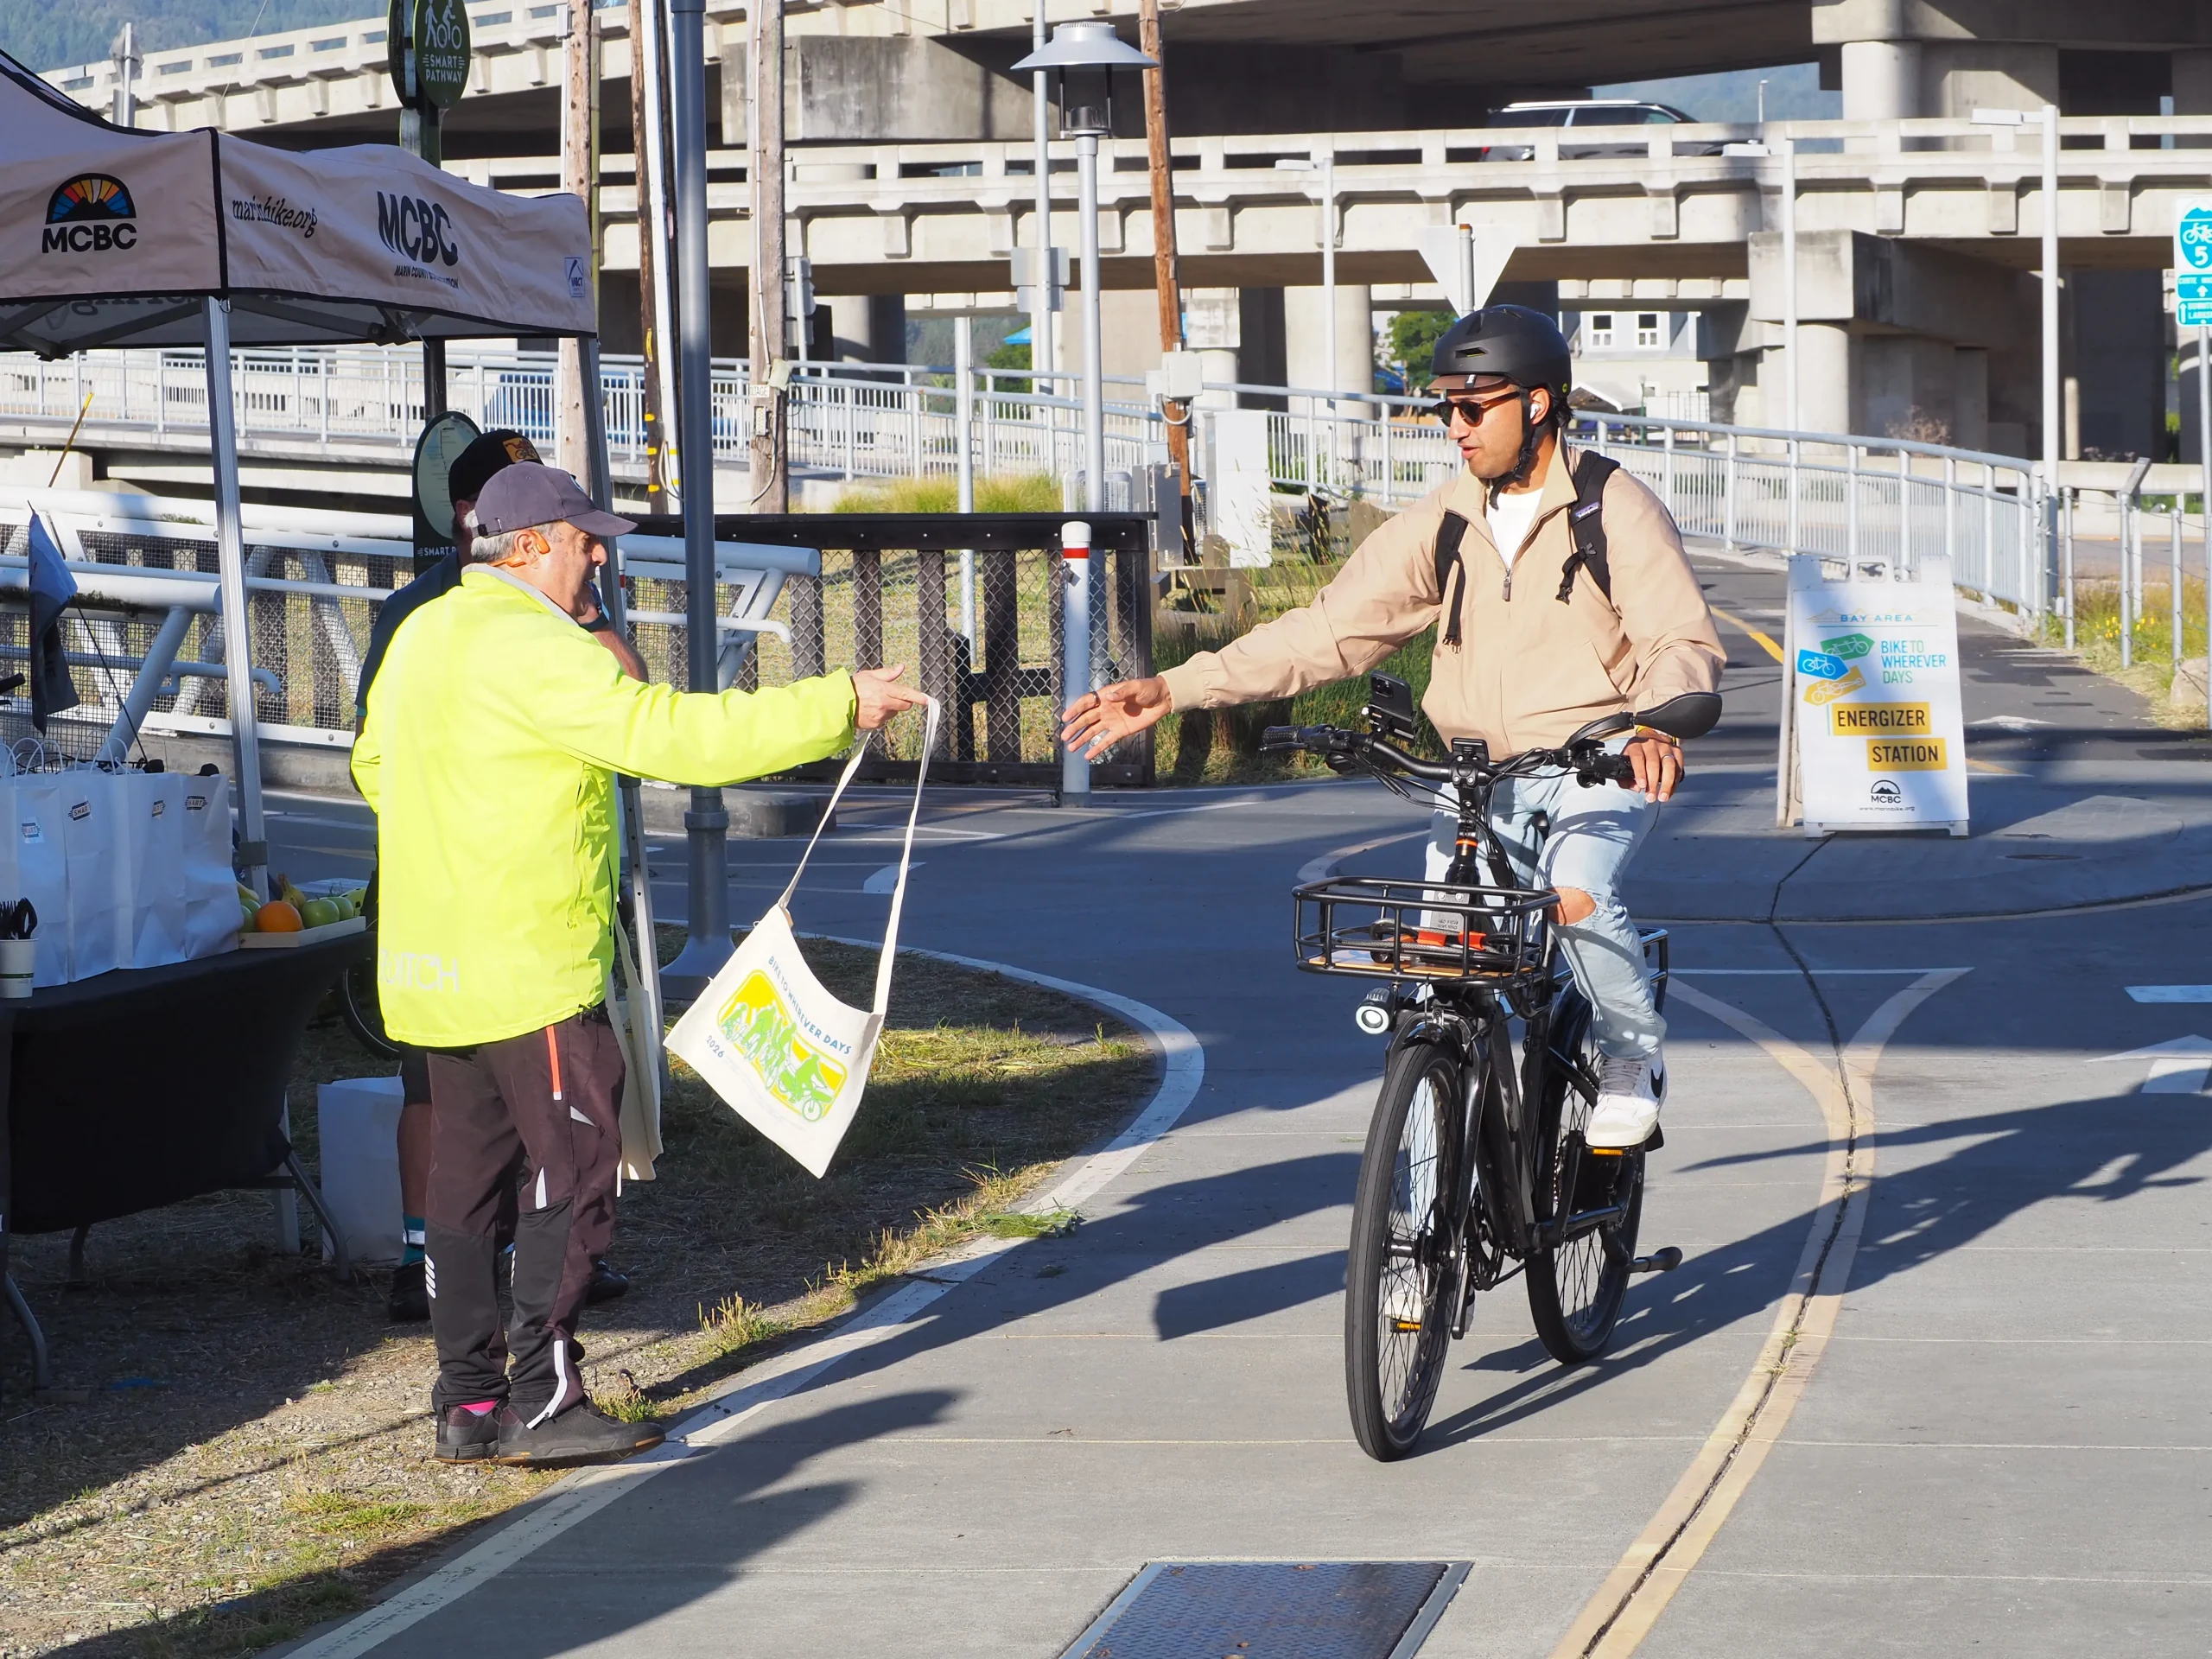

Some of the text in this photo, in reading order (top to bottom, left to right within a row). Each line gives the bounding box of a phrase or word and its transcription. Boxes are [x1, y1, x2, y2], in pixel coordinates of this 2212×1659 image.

[429, 54, 457, 68] SMART
[425, 69, 462, 83] PATHWAY
[377, 191, 459, 266] MCBC
[42, 223, 137, 253] MCBC
[2194, 245, 2209, 266] 5
[423, 547, 449, 556] SMART
[1881, 640, 1924, 653] BIKE TO
[1881, 655, 1946, 668] WHEREVER
[1883, 671, 1913, 683] DAYS
[1837, 709, 1925, 727] ENERGIZER
[1872, 746, 1938, 762] STATION
[1871, 795, 1901, 804] MCBC
[768, 956, 851, 1054] BIKE TO WHEREVER DAYS
[706, 1035, 725, 1058] 2026
